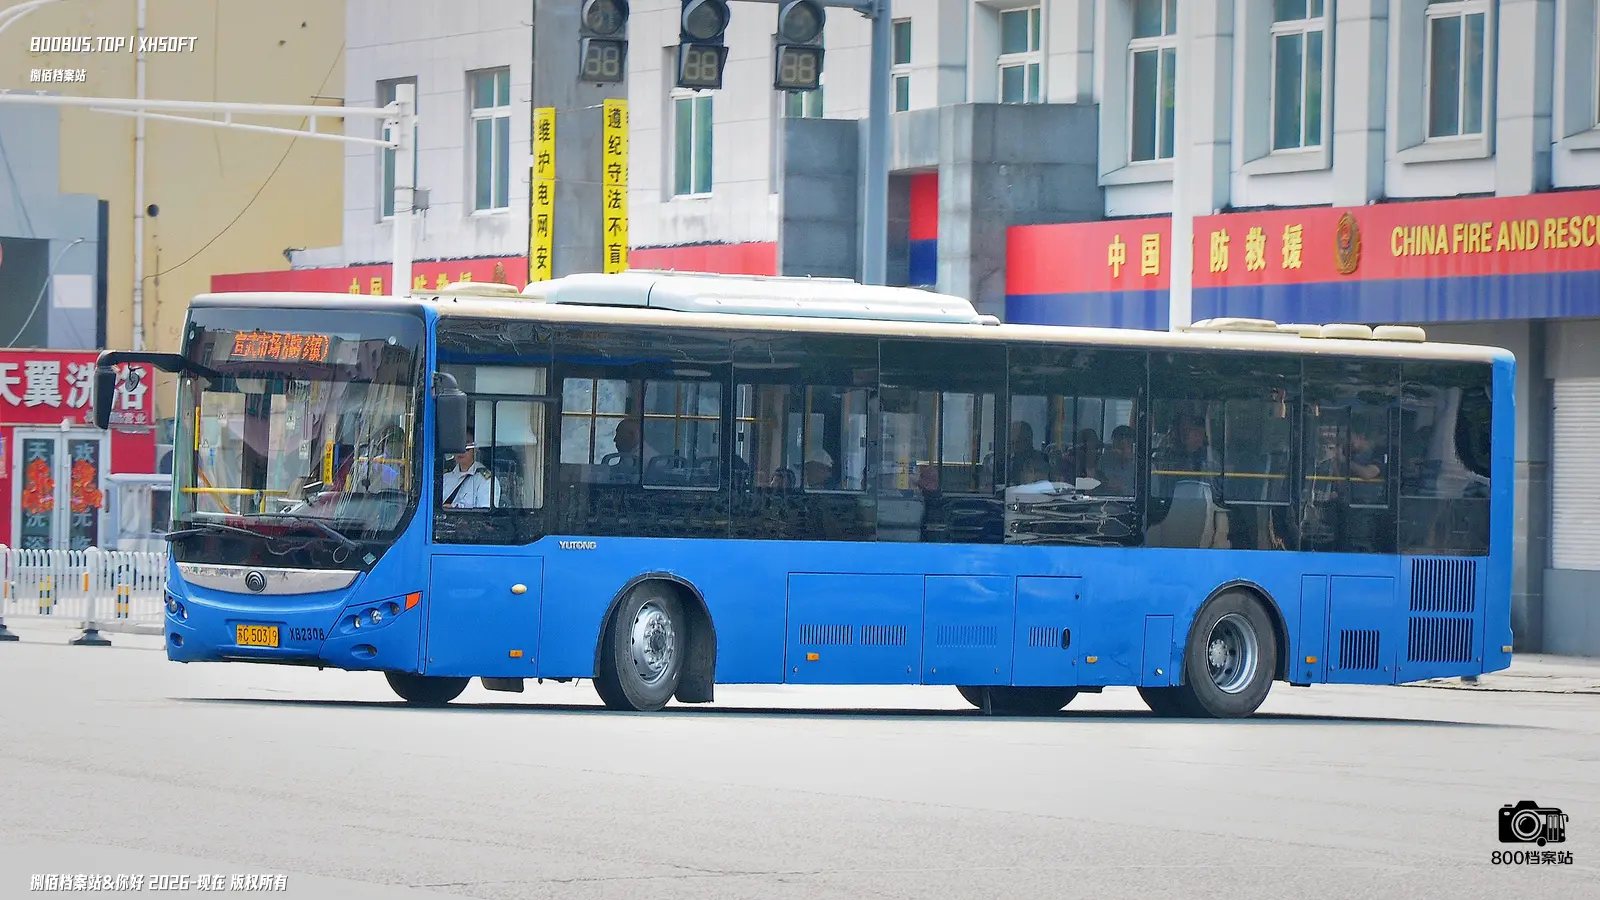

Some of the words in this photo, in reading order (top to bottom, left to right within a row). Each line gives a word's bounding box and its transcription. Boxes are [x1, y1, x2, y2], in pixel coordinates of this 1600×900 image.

[537, 118, 551, 282] 维护电网安
[608, 108, 622, 274] 遵纪守法不盲
[1108, 224, 1304, 278] 中国防救援
[1391, 223, 1449, 257] CHINA
[1452, 221, 1493, 254] FIRE
[1496, 218, 1540, 252] AND
[558, 540, 597, 550] YUTONG
[289, 627, 325, 641] XB2308
